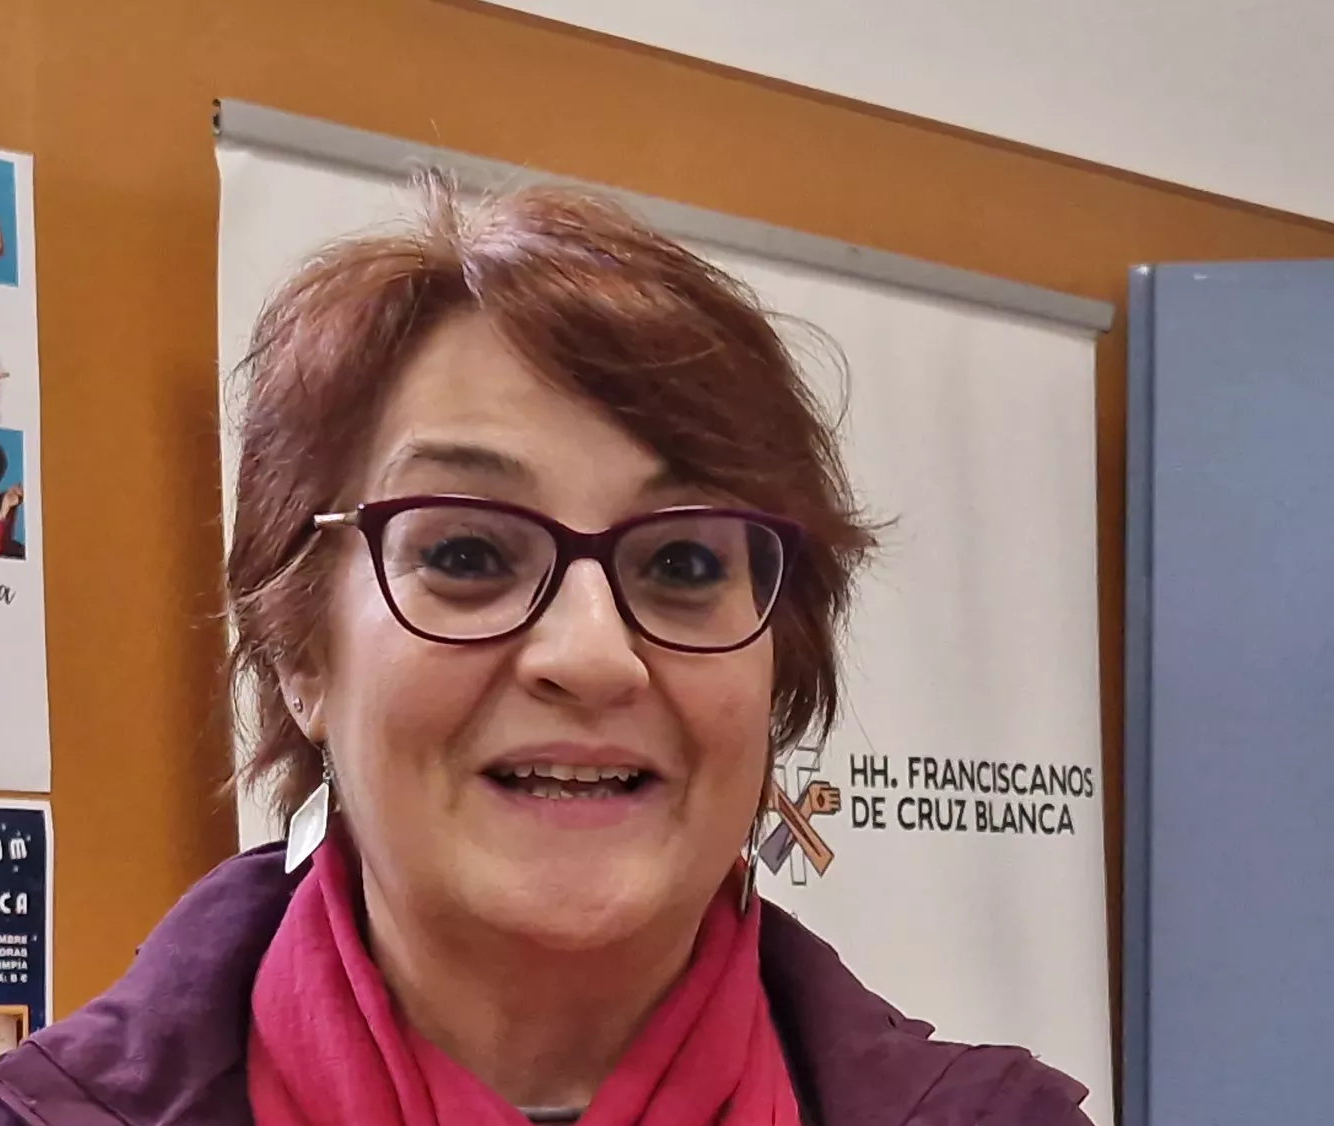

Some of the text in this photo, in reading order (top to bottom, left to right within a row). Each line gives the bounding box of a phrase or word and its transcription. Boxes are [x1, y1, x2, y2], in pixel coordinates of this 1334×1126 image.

[849, 753, 1094, 798] HH. FRANCISCANOS
[851, 795, 1076, 836] DE CRUZ BLANCA
